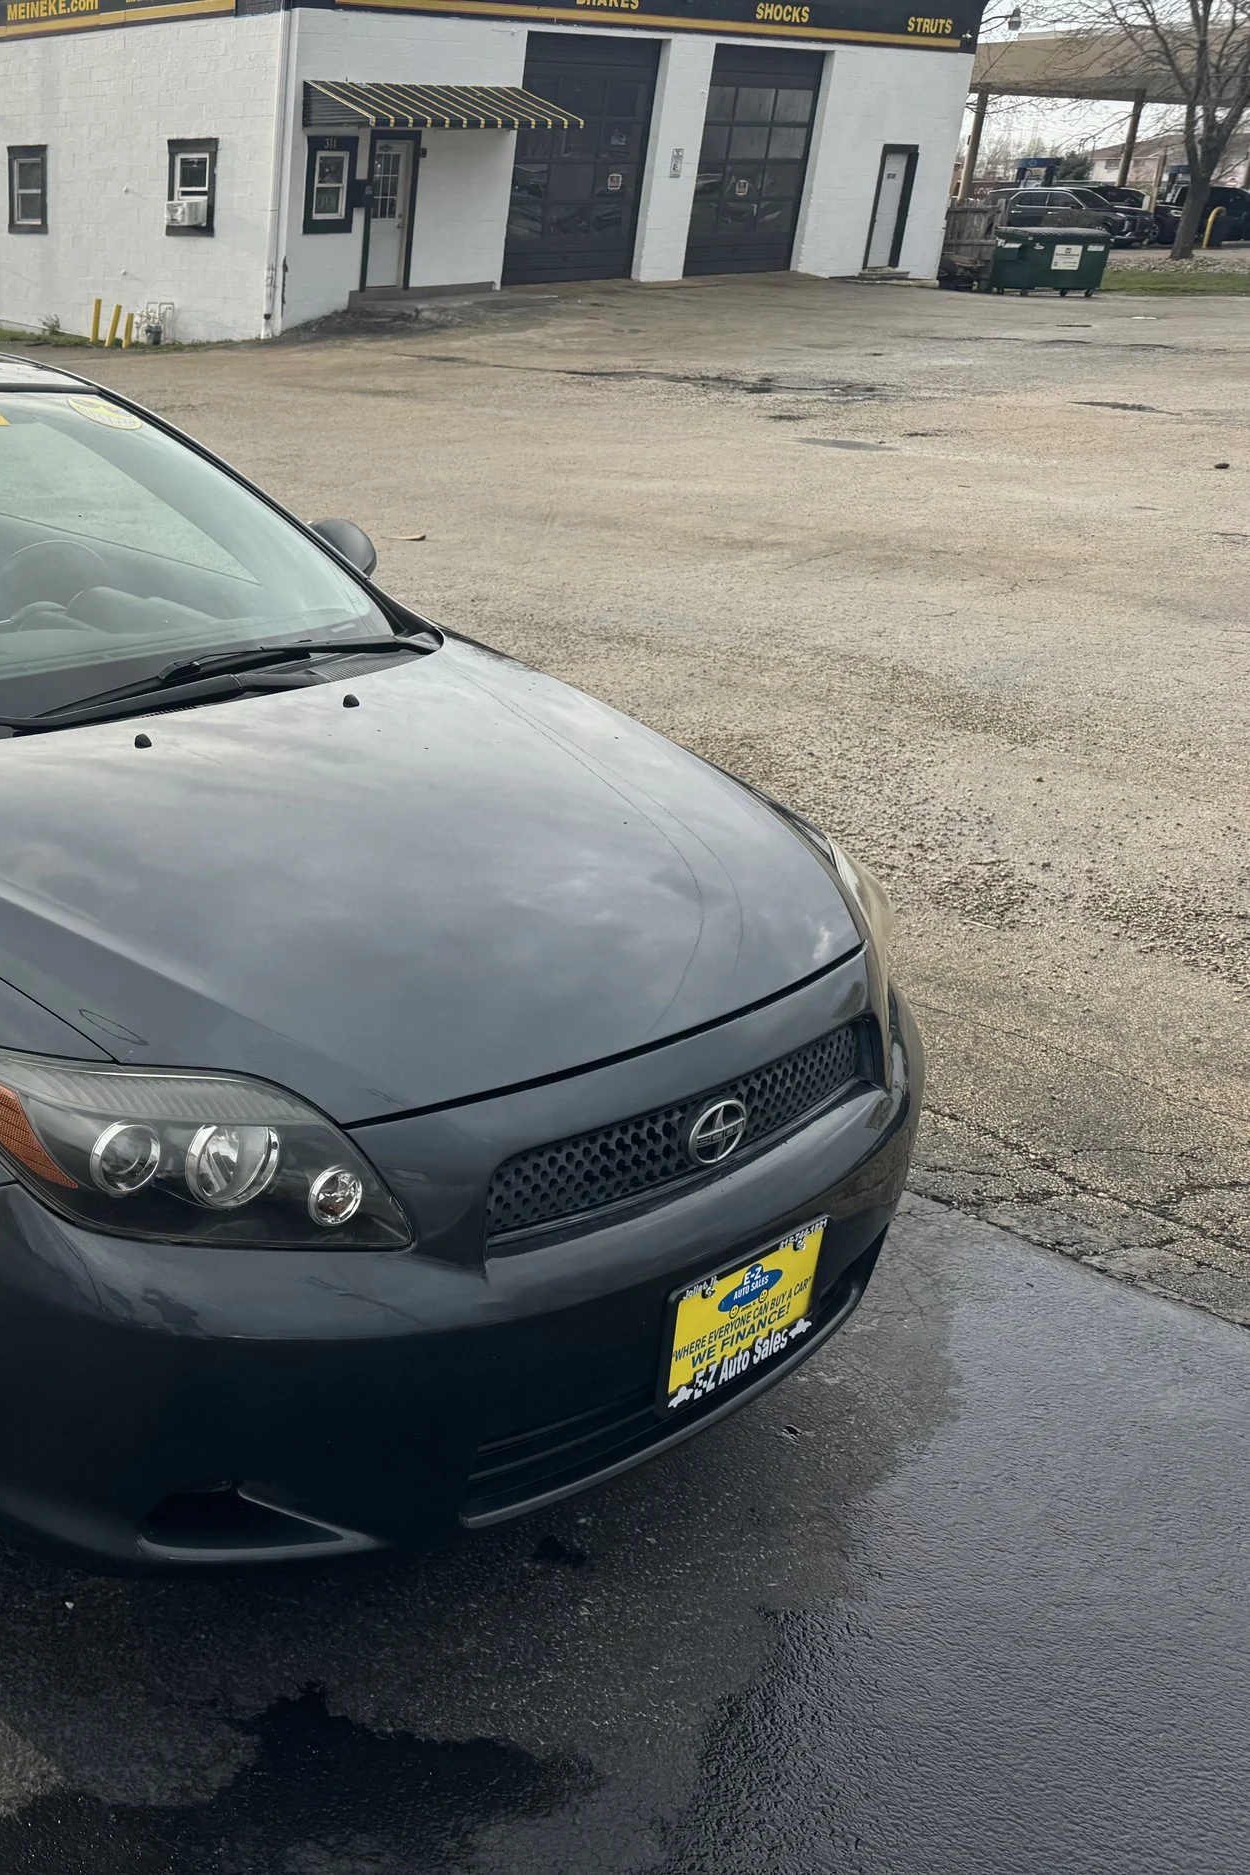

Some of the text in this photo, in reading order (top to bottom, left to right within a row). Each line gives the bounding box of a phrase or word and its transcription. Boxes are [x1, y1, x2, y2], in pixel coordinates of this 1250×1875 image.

[7, 0, 99, 21] MEINEKE.com
[755, 2, 810, 23] SHOCKS
[907, 16, 953, 34] STRUTS
[733, 1274, 769, 1301] AUTO SALES
[743, 1266, 762, 1286] E-Z
[708, 1311, 752, 1344] EVERYONE
[753, 1302, 769, 1320] CAN
[770, 1291, 788, 1310] BUY
[691, 1302, 790, 1368] WE FINANCE!
[718, 1349, 750, 1386] Auto
[752, 1328, 789, 1364] Sales
